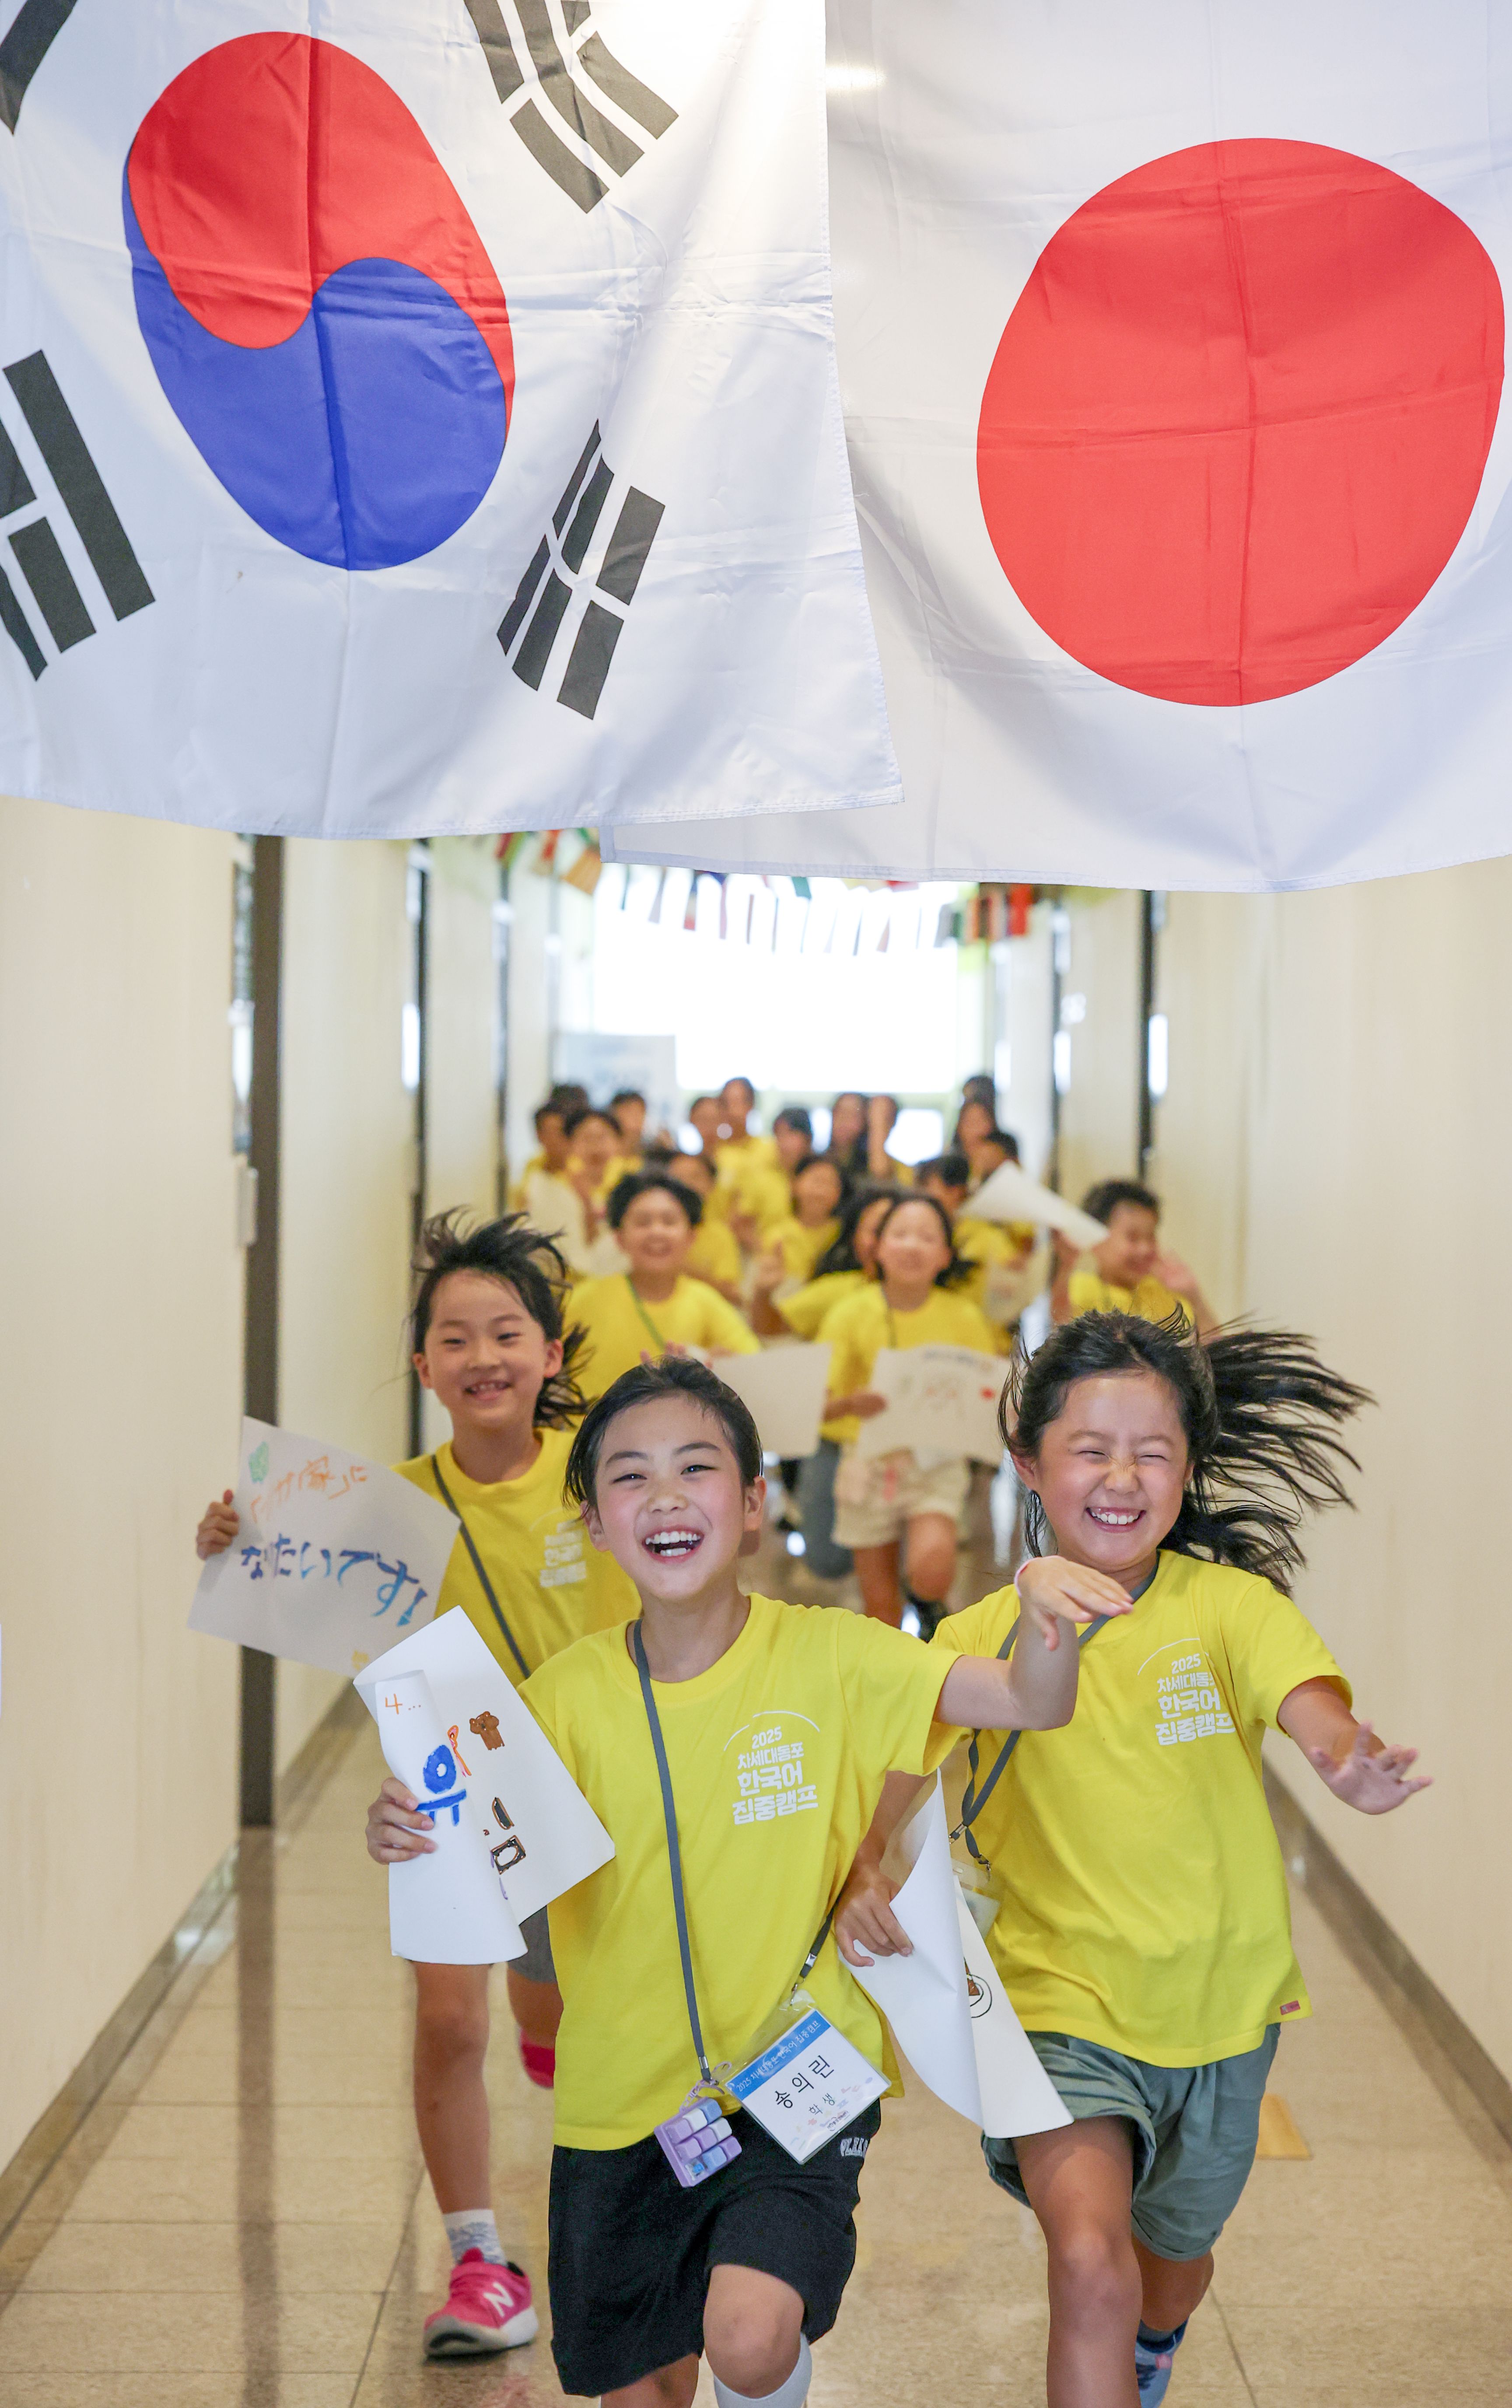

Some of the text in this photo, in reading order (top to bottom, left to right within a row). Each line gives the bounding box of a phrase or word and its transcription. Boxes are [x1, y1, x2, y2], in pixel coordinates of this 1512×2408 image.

[1171, 1653, 1201, 1674] 2025
[1157, 1688, 1221, 1719] 한국어
[752, 1726, 782, 1749] 2025
[1155, 1712, 1236, 1746] 집중캠프
[737, 1742, 804, 1770] 차세대동포
[737, 1760, 803, 1797] 한국어
[732, 1785, 819, 1825] 집중캠프
[736, 2077, 752, 2092] 2025
